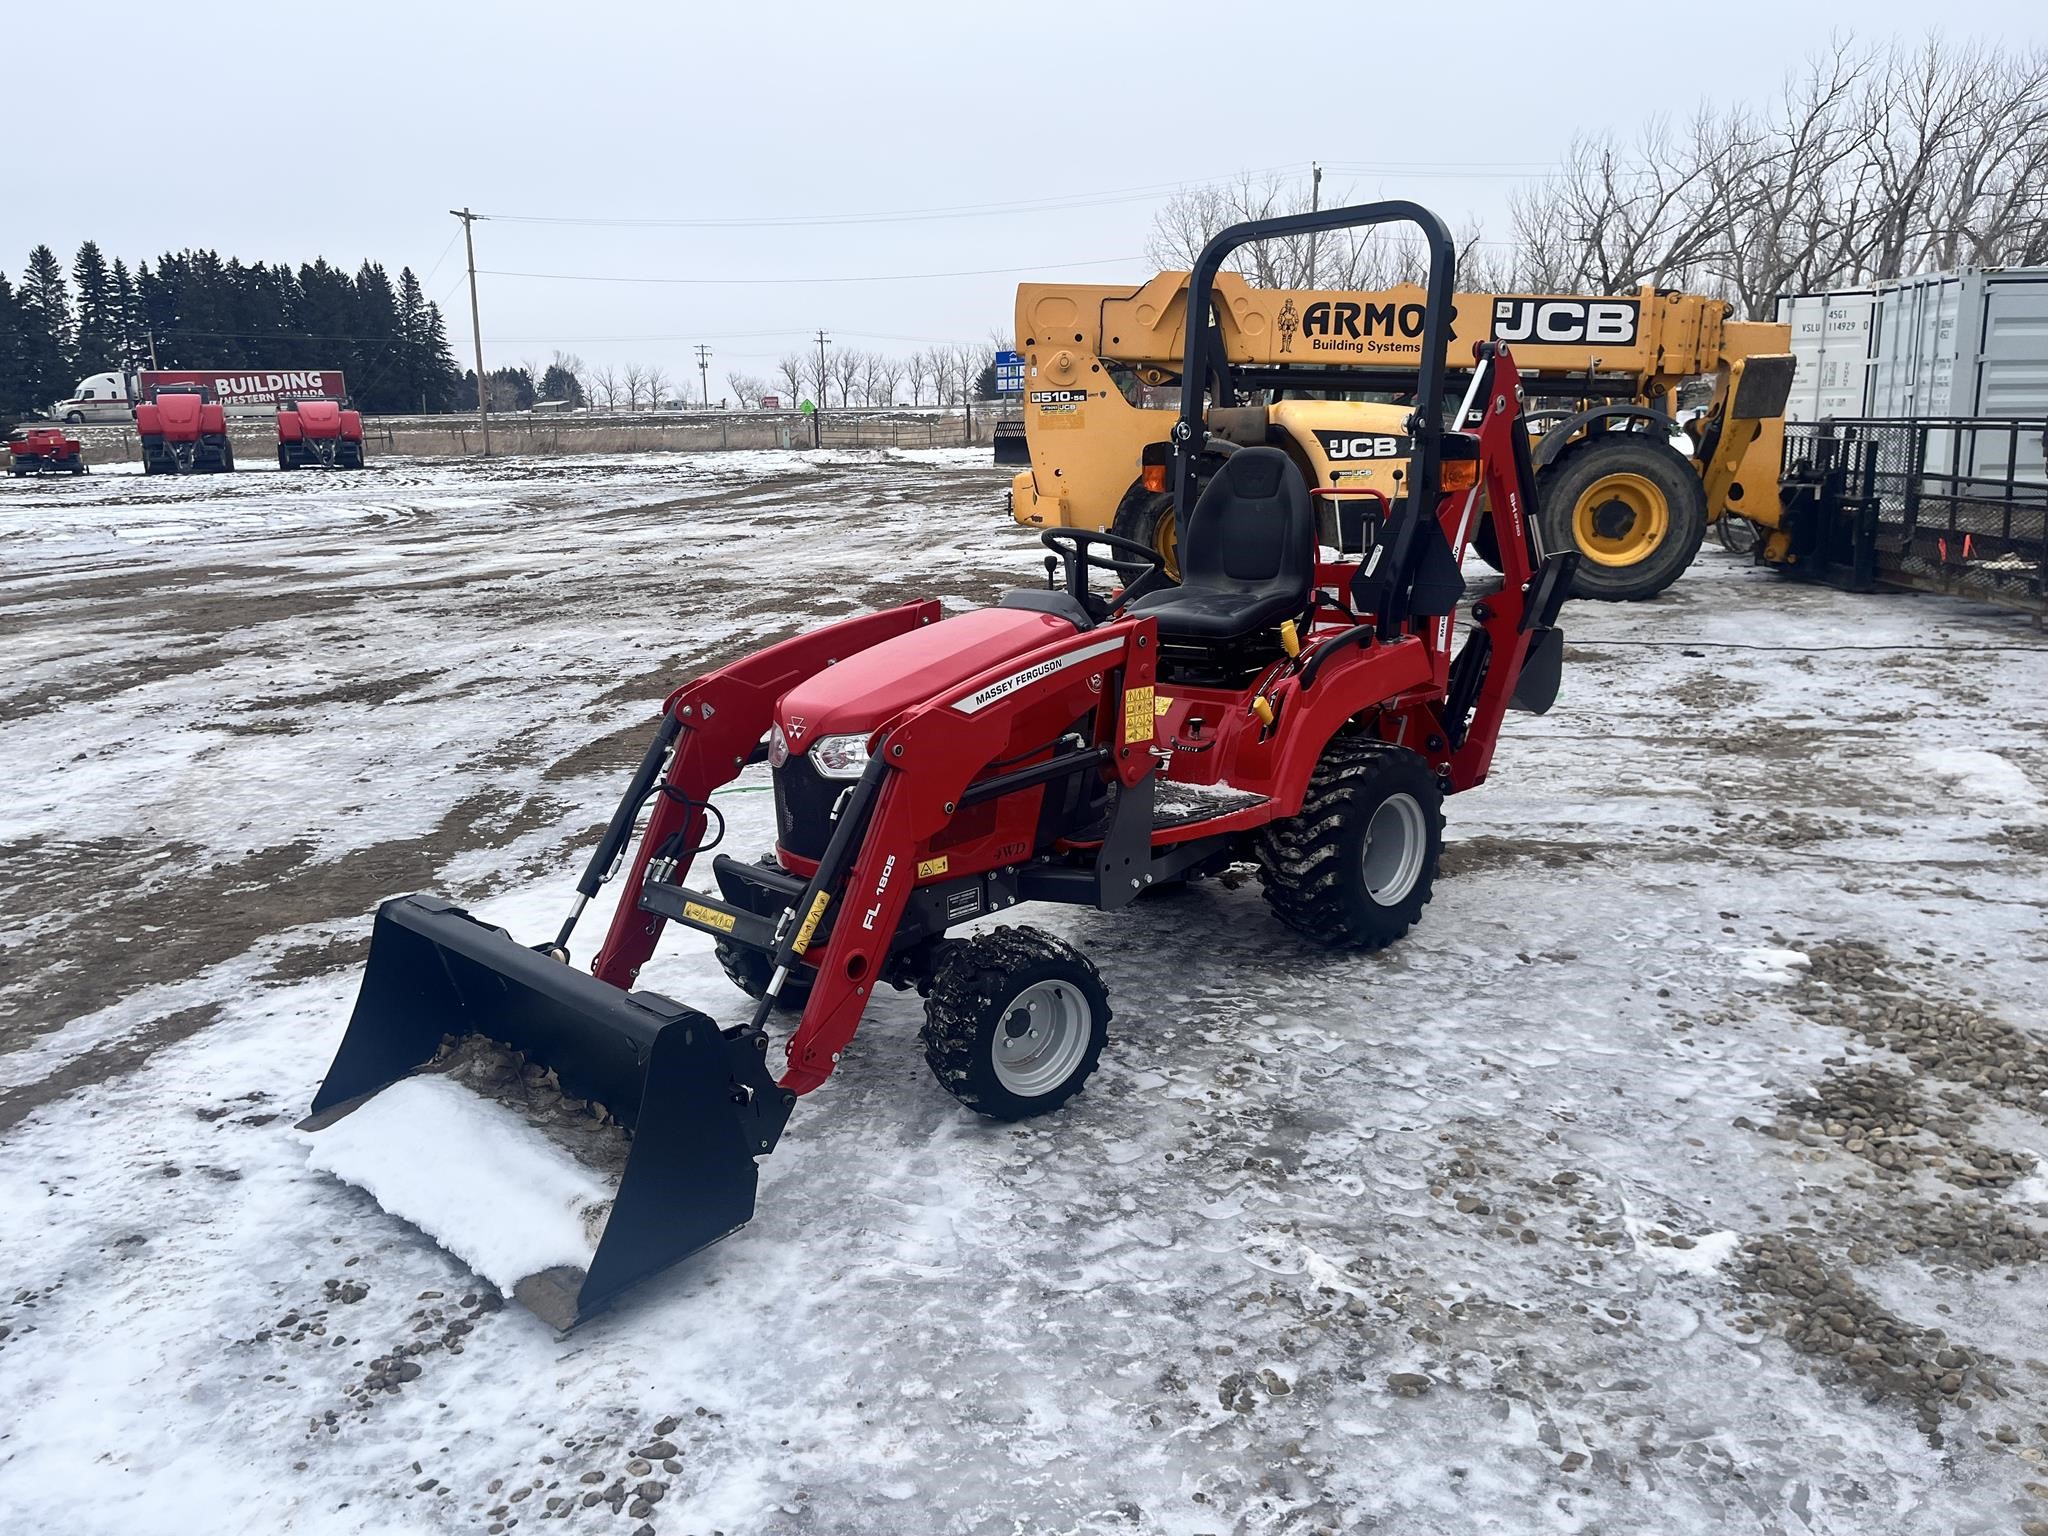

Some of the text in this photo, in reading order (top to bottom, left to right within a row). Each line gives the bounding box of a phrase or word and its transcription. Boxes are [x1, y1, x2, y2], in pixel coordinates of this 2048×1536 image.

[1495, 302, 1635, 342] JCB
[1829, 310, 1848, 319] 45G1
[1802, 323, 1821, 332] VSLU
[1829, 321, 1856, 331] 114929
[1312, 338, 1421, 353] Building Systems
[215, 372, 323, 395] BUILDING
[1329, 438, 1398, 459] JCB
[975, 659, 1063, 706] MASSEY FERGUSON
[862, 854, 896, 930] FL 1805
